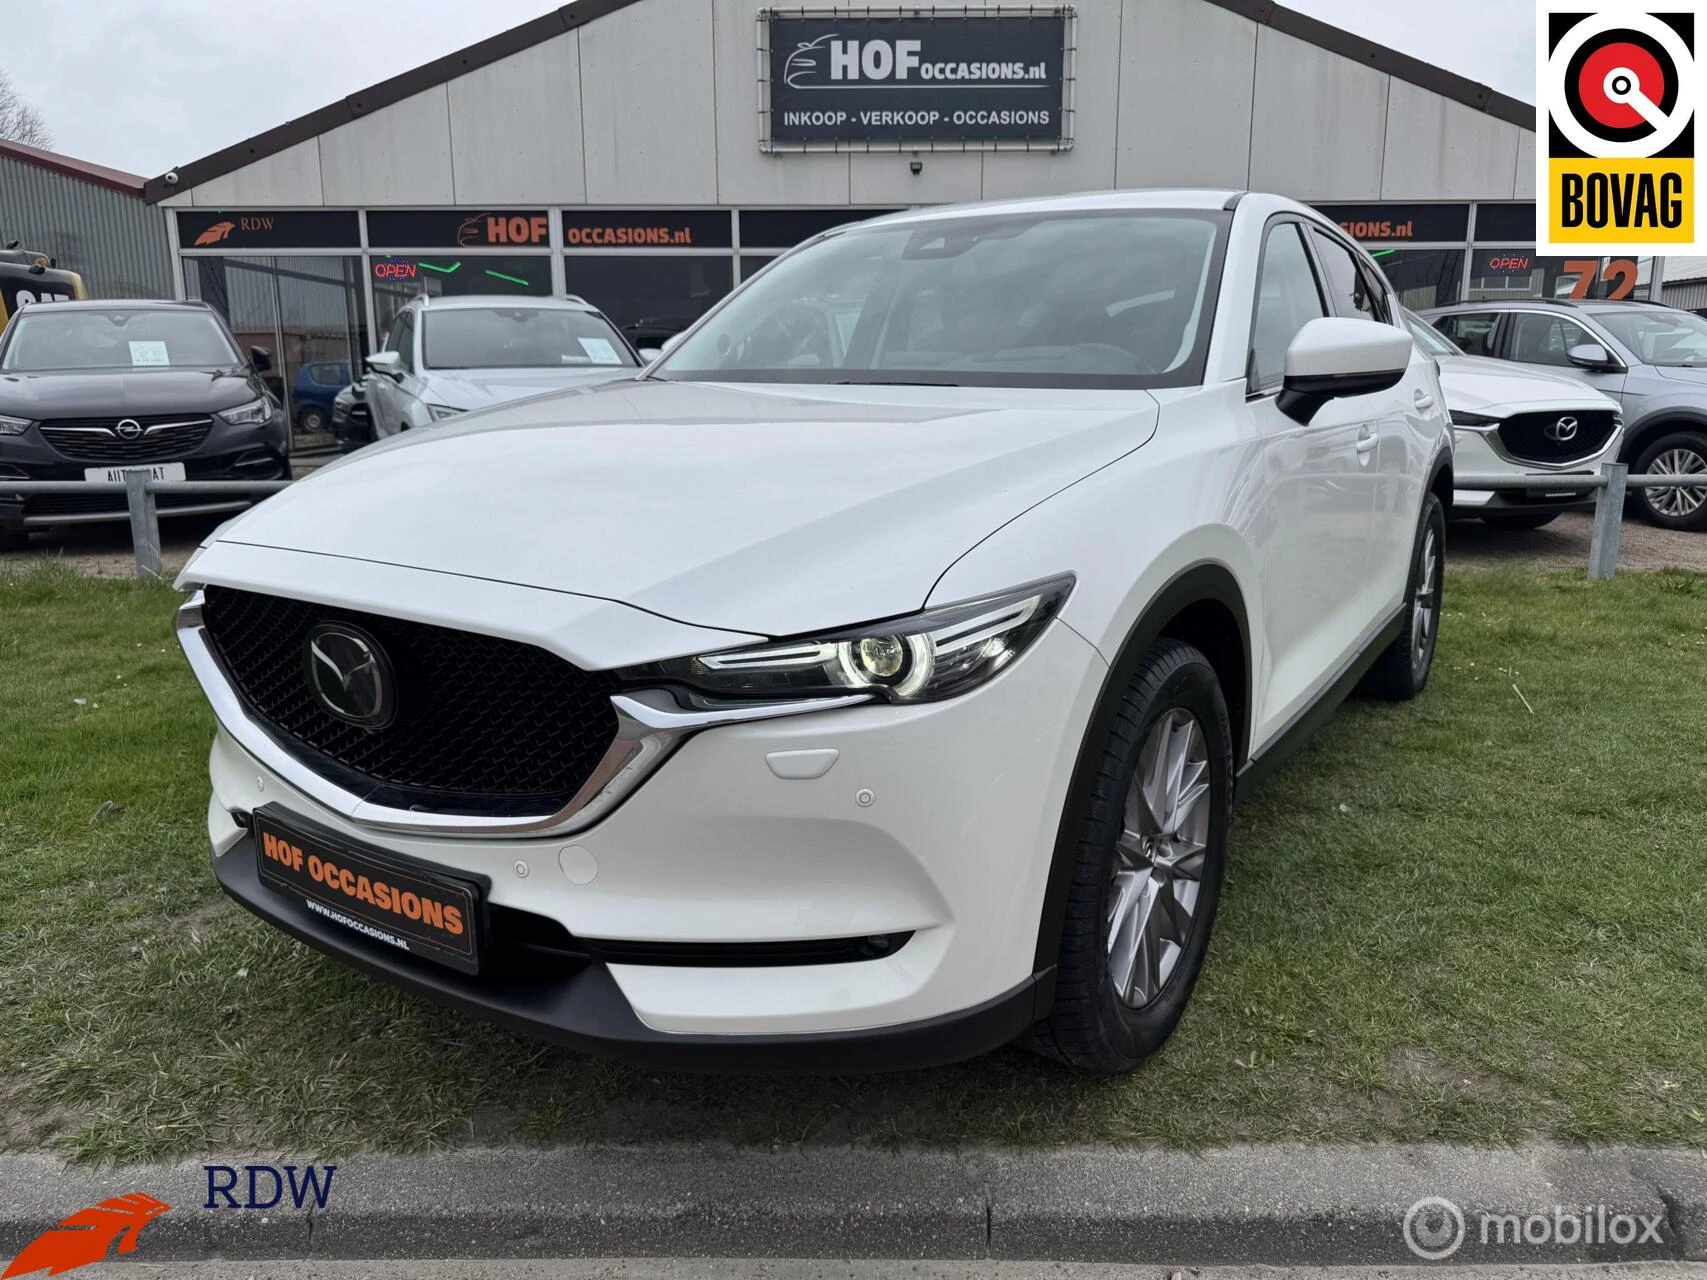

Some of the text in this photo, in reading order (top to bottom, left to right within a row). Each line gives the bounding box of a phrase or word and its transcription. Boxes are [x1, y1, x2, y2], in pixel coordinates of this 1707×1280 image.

[784, 112, 847, 126] INKOOP
[860, 111, 940, 126] VERKOOP
[953, 110, 1050, 125] OCCASIONS
[240, 217, 274, 231] RDW
[487, 216, 692, 244] HOF OCCASIONS.nl
[1339, 220, 1413, 238] SIONS.nl
[374, 263, 417, 278] OPEN
[1489, 256, 1529, 270] OPEN
[1563, 259, 1639, 301] 72
[263, 832, 465, 935] HOF OCCASIONS
[306, 899, 410, 951] WWW.HOFOCCASIONS.NL
